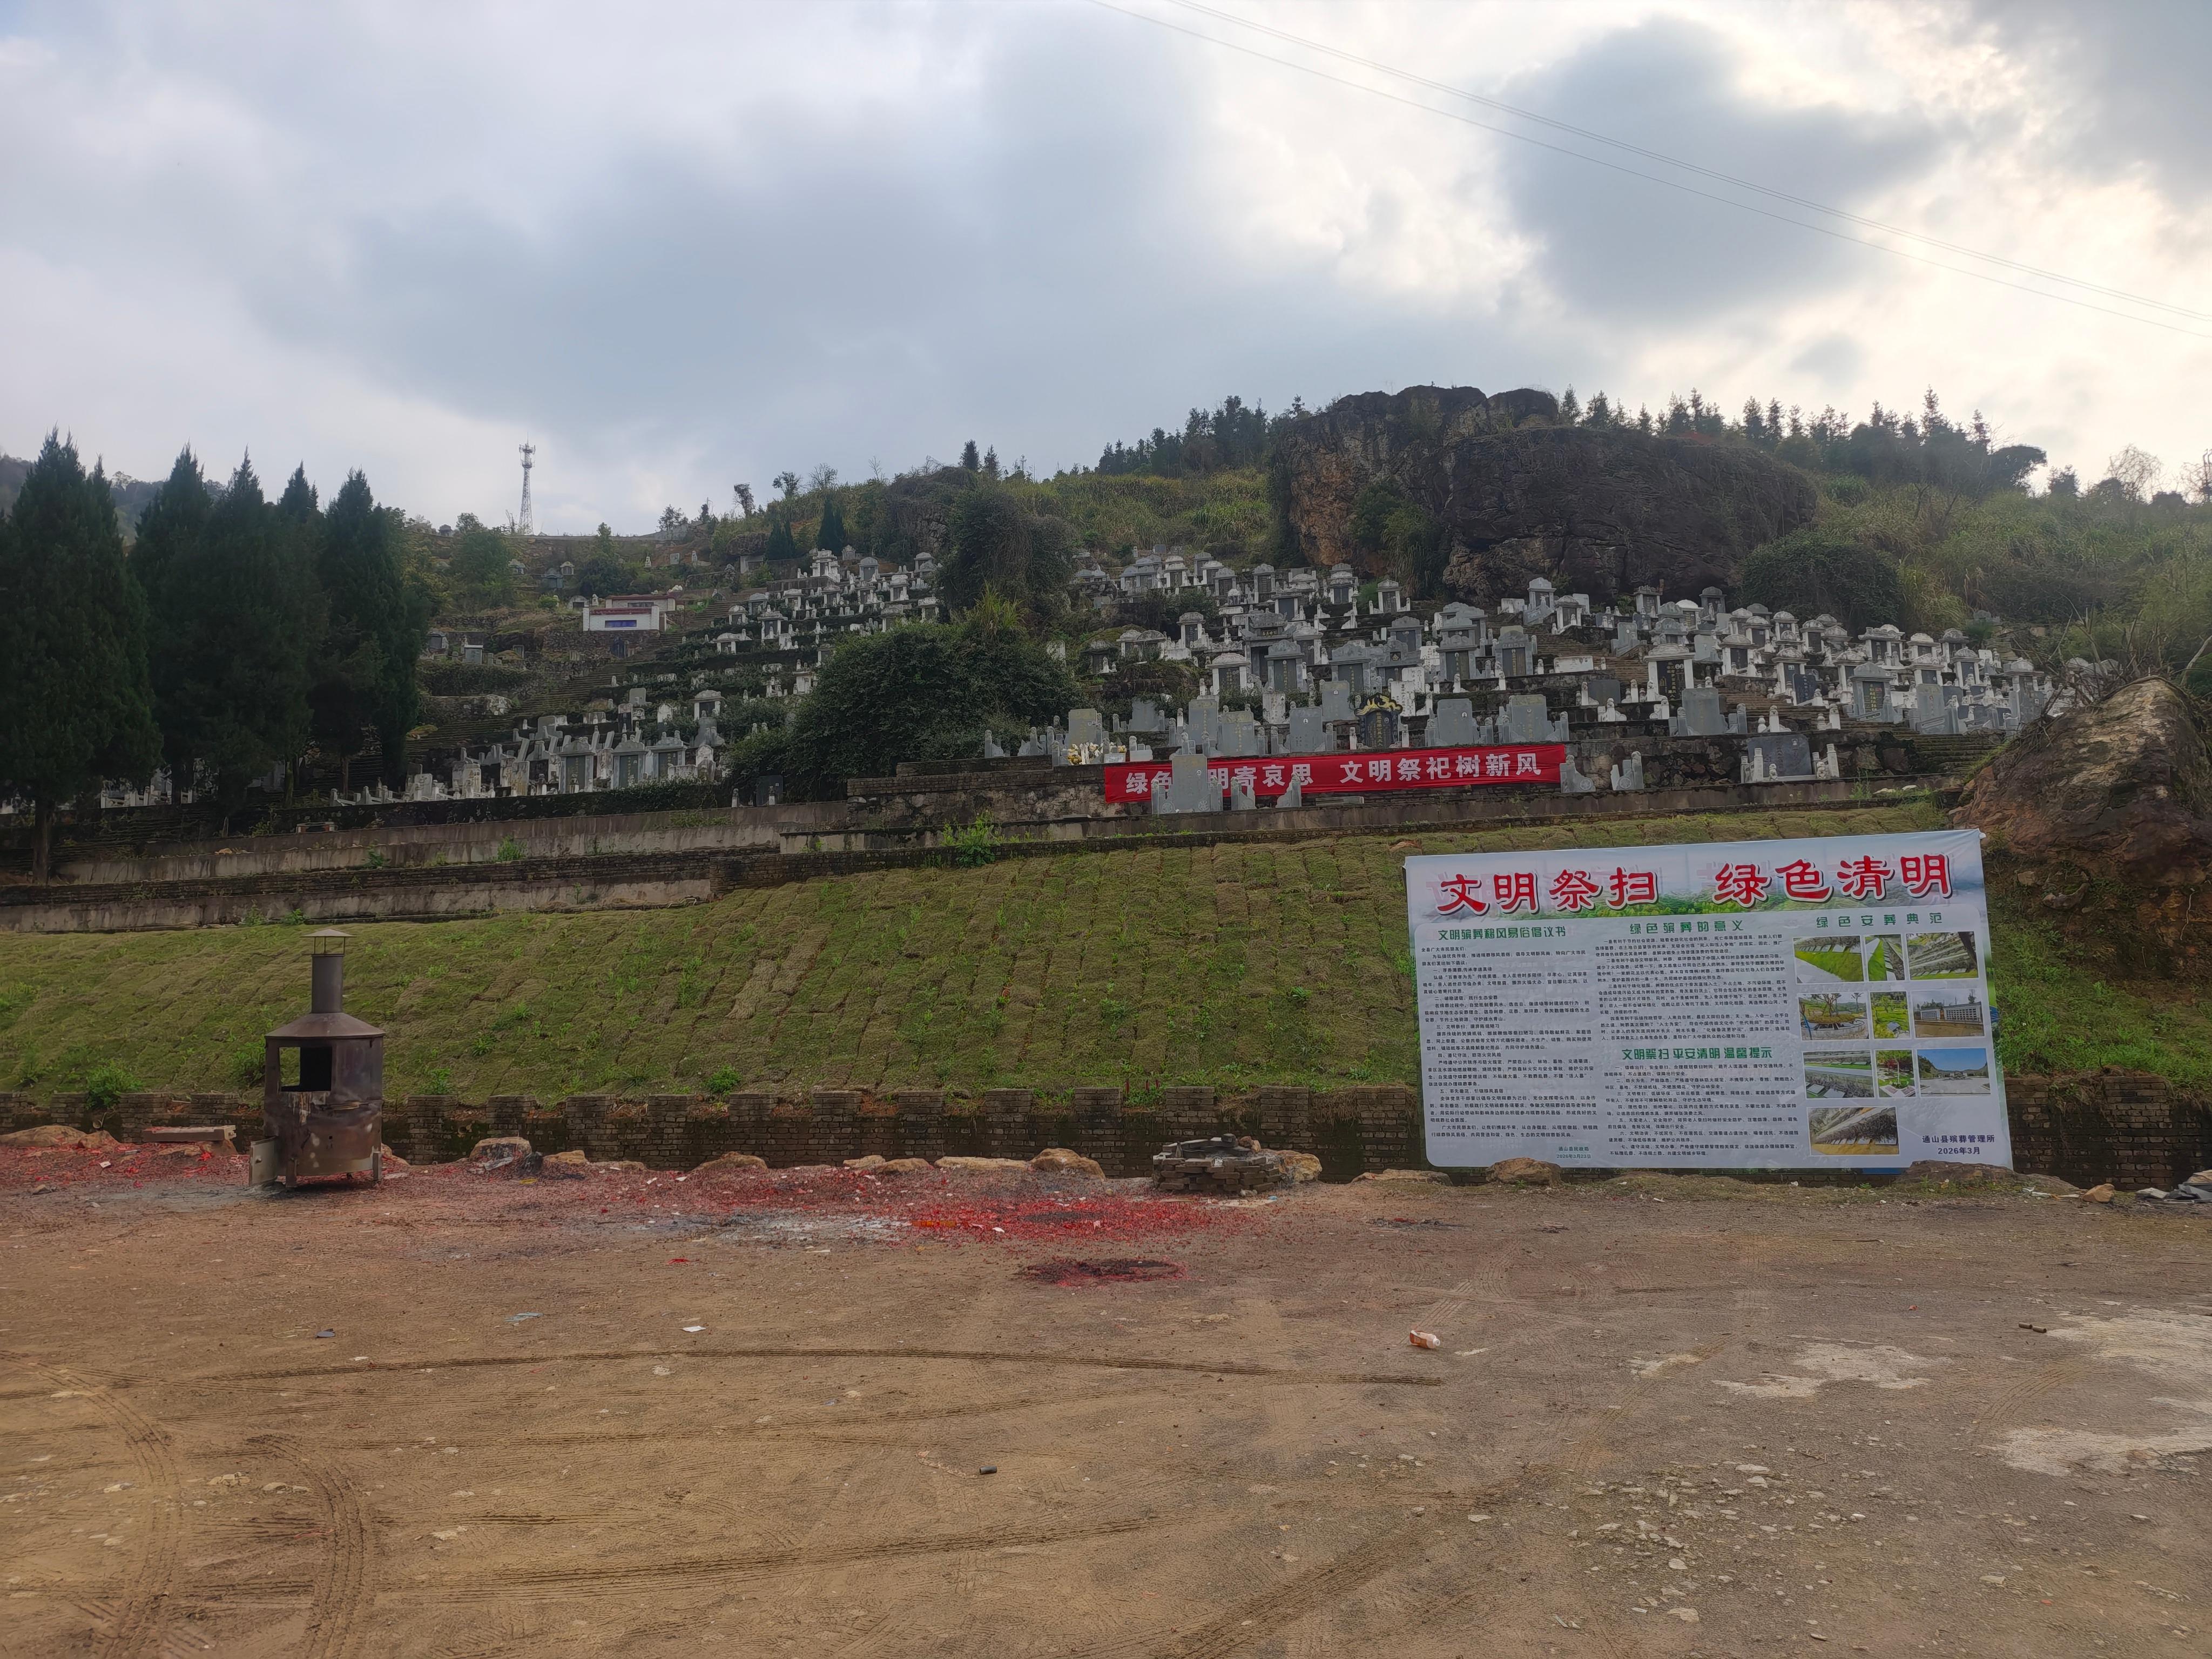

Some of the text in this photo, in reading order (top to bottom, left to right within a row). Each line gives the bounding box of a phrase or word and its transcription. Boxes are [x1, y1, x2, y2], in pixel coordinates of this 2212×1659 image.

[1126, 753, 1541, 794] 绿色明寄哀思 文明祭祀树新风
[1437, 852, 1952, 915] 文明祭扫 绿色清明
[1629, 920, 1744, 935] 绿色殡葬的意义
[1816, 912, 1943, 928] 绿色安葬典范
[1438, 926, 1566, 941] 文明殡葬移风易俗倡议书
[1622, 1047, 1773, 1060] 文明祭扫 平安清明 温馨提示
[1921, 1134, 1995, 1144] 通山县殡葬管理所
[1937, 1147, 1981, 1156] 2026年3月
